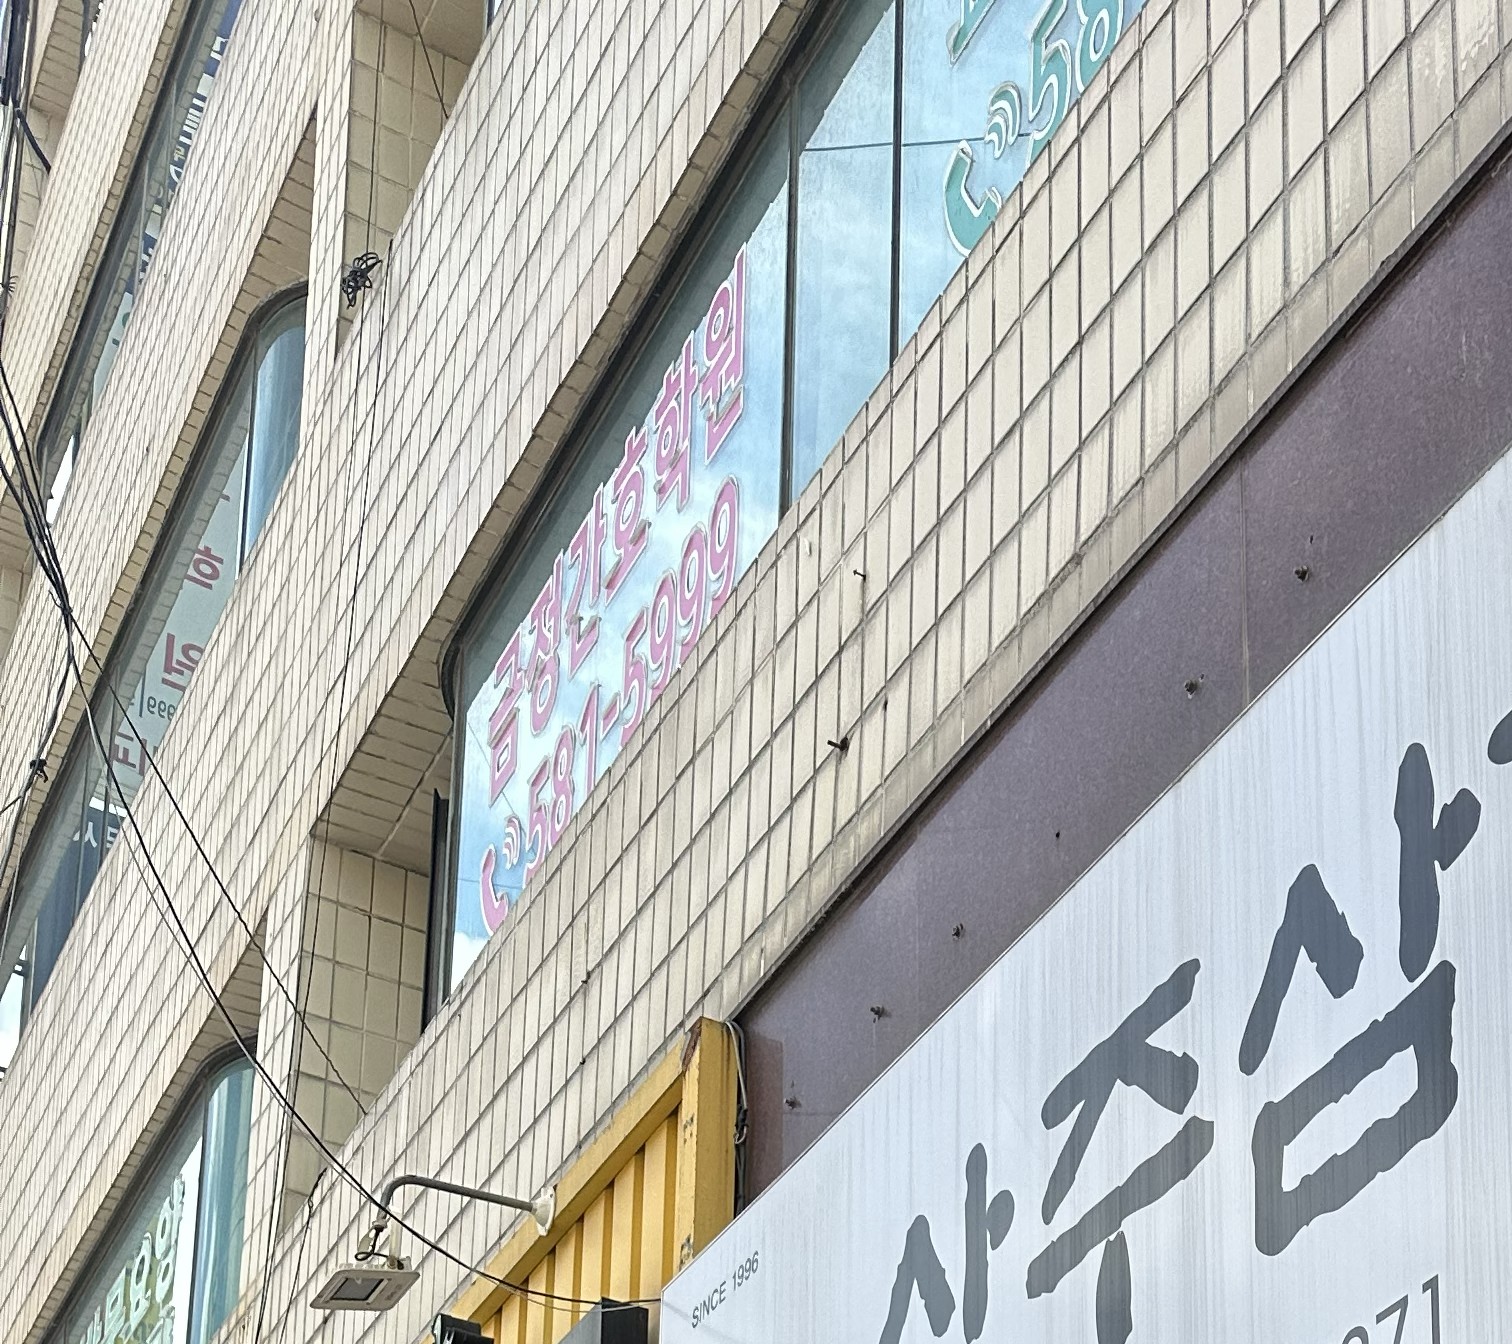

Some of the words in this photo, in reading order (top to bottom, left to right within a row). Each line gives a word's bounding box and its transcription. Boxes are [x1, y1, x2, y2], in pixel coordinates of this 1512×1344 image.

[488, 240, 748, 806] 금정간호학원
[692, 1281, 727, 1328] SINCE
[731, 1251, 759, 1292] 1996
